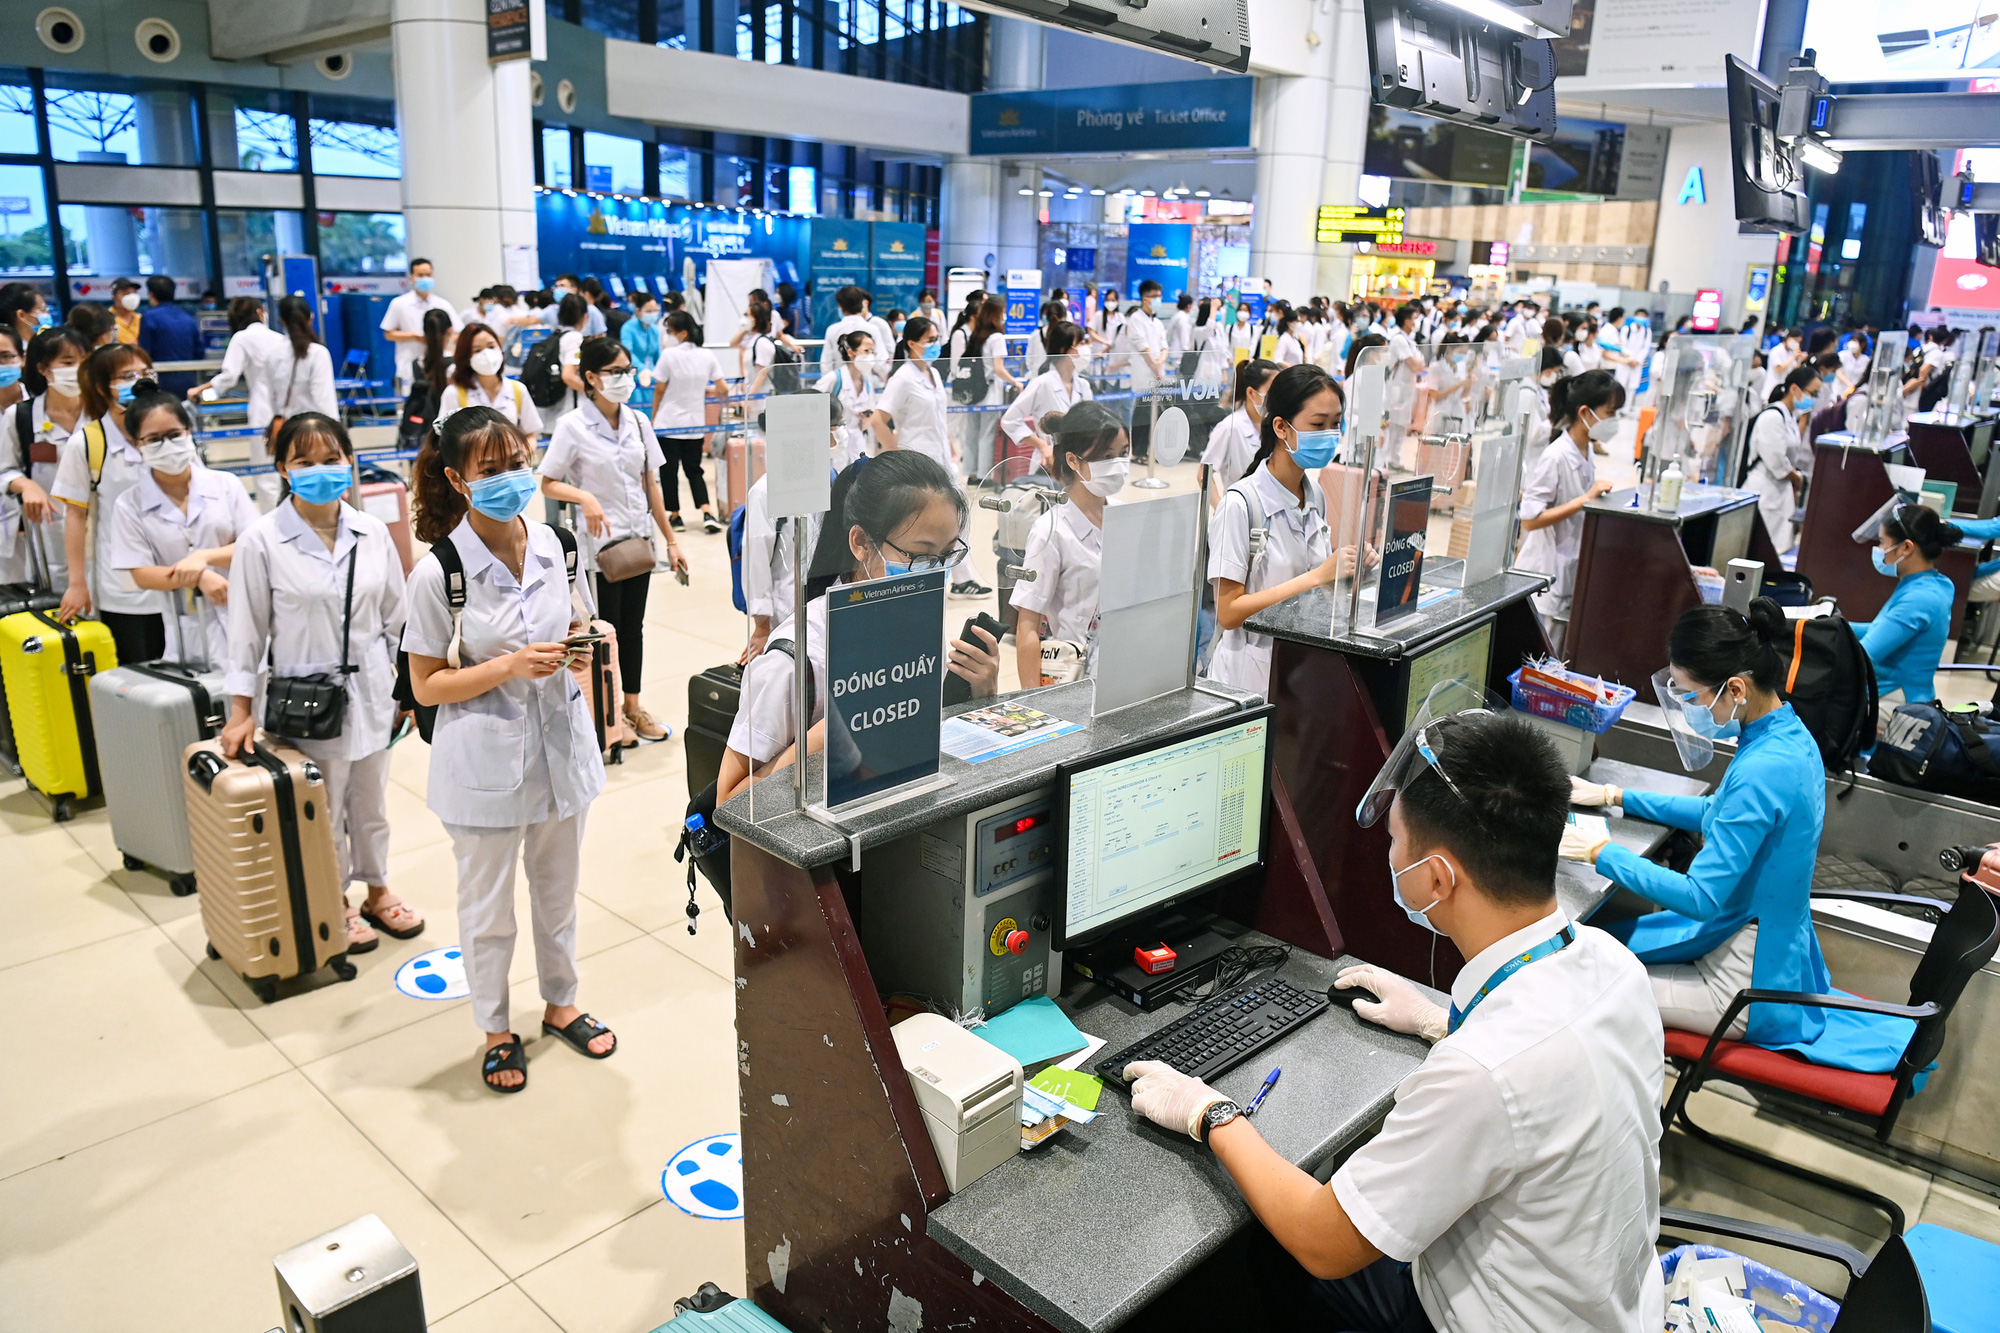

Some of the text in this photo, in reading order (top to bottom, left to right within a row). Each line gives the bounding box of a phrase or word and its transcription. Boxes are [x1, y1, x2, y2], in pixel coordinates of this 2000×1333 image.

[1076, 108, 1124, 131] Phòng
[1155, 109, 1189, 124] Ticket
[1191, 107, 1228, 123] Office
[1677, 166, 1706, 205] A
[1008, 303, 1025, 320] 40
[1385, 538, 1406, 555] ĐÓNG
[1388, 560, 1415, 579] CLOSED
[833, 654, 937, 698] ĐÓNG QUẦY
[850, 698, 921, 732] CLOSED
[1885, 713, 1931, 751] NIKE
[1504, 958, 1523, 973] VIAGS
